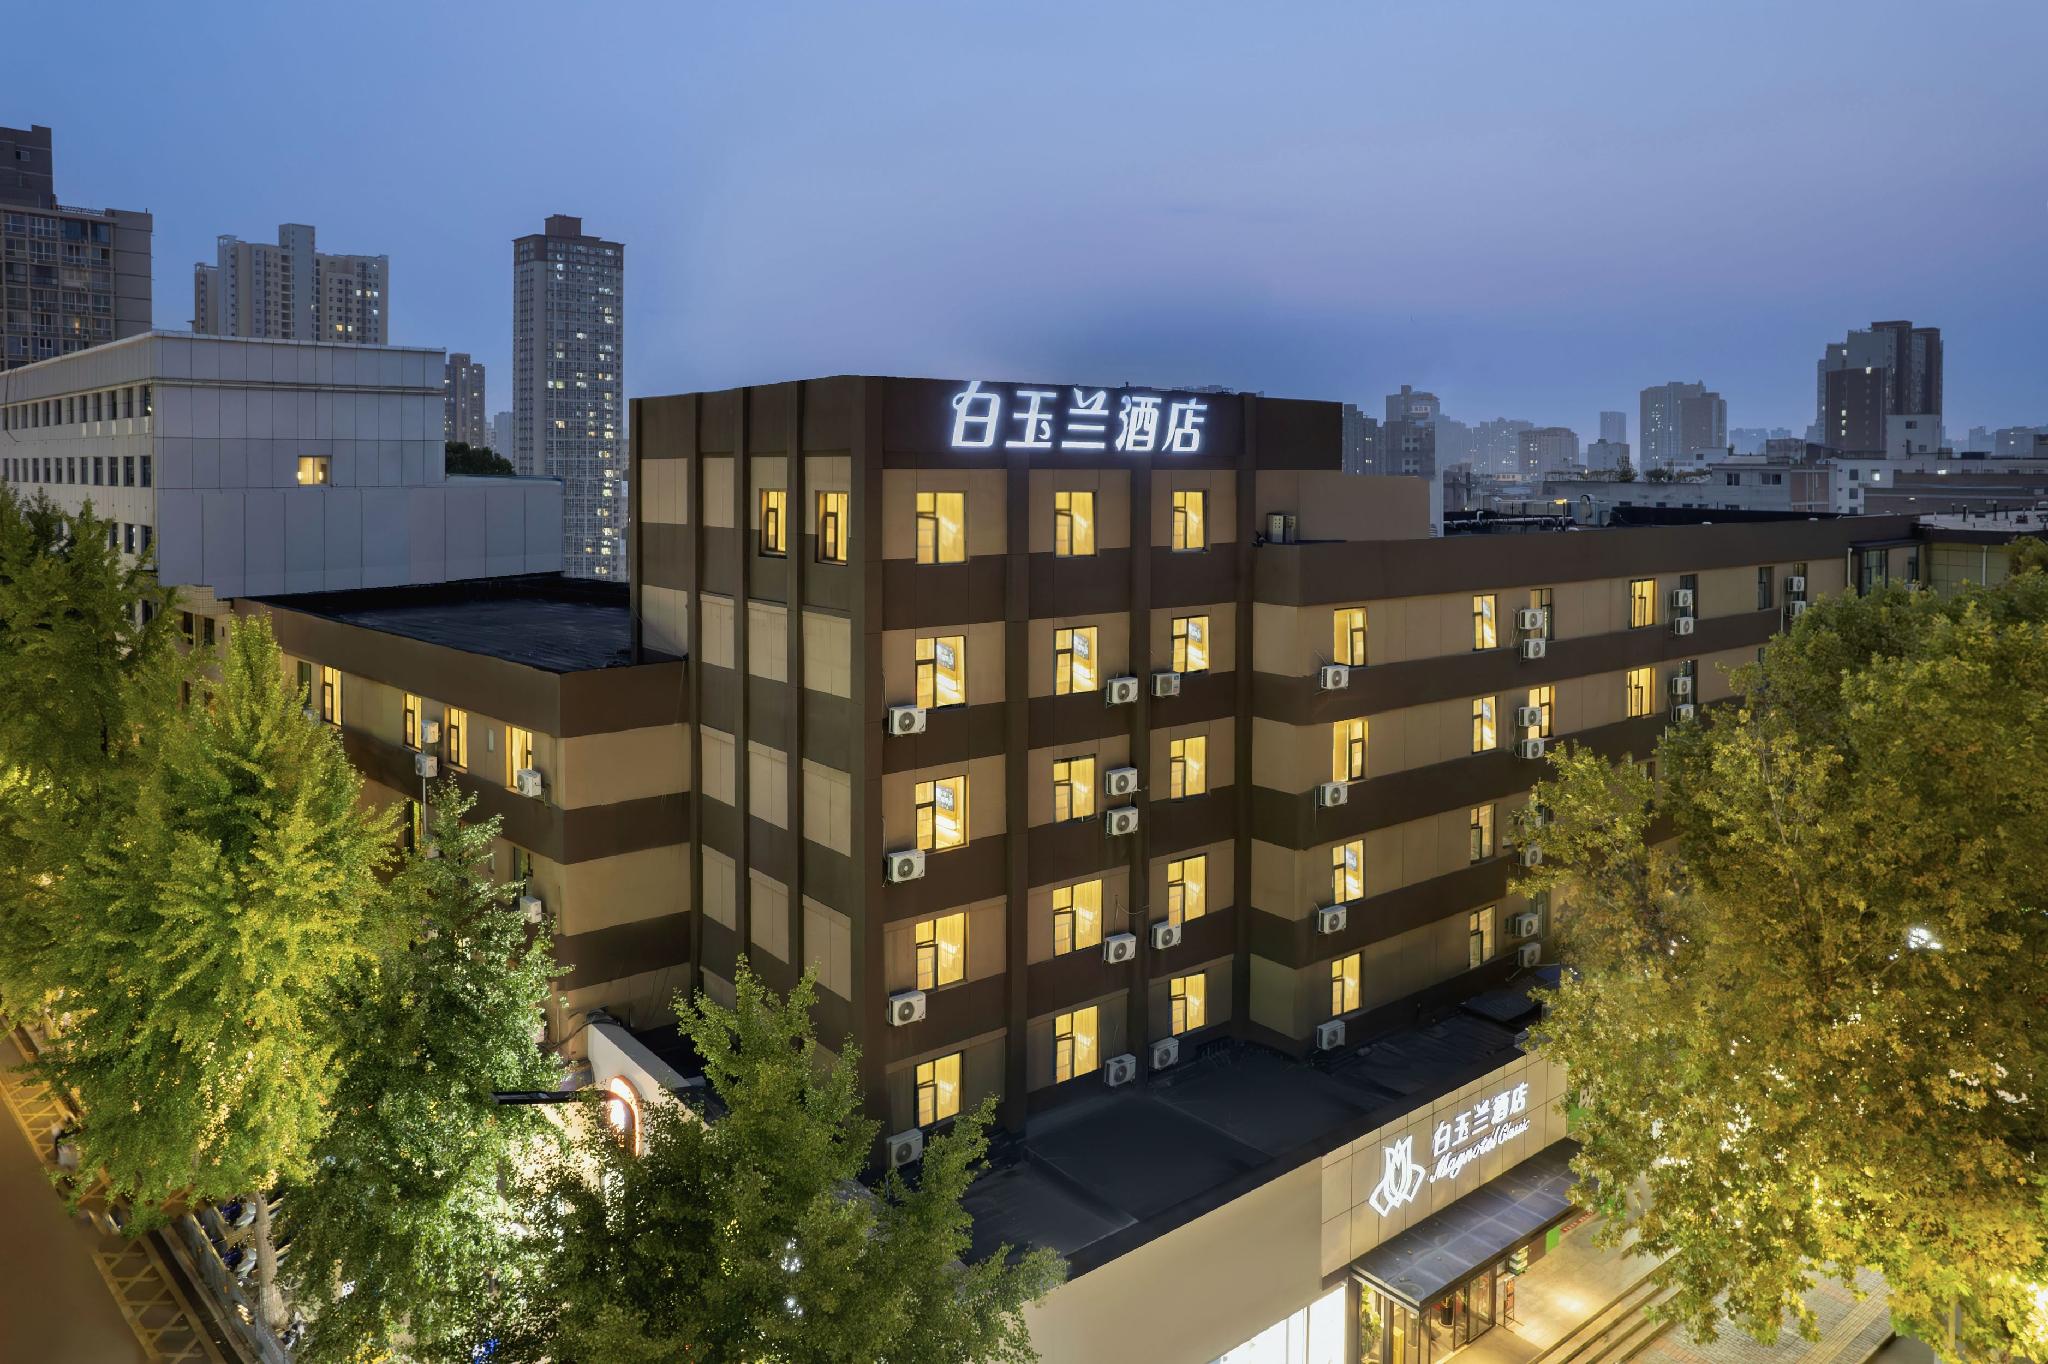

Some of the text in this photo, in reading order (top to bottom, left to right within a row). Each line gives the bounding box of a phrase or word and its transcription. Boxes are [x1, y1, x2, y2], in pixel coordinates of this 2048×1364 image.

[952, 381, 1208, 452] 白玉兰酒店
[1432, 1082, 1529, 1157] 白玉兰酒店
